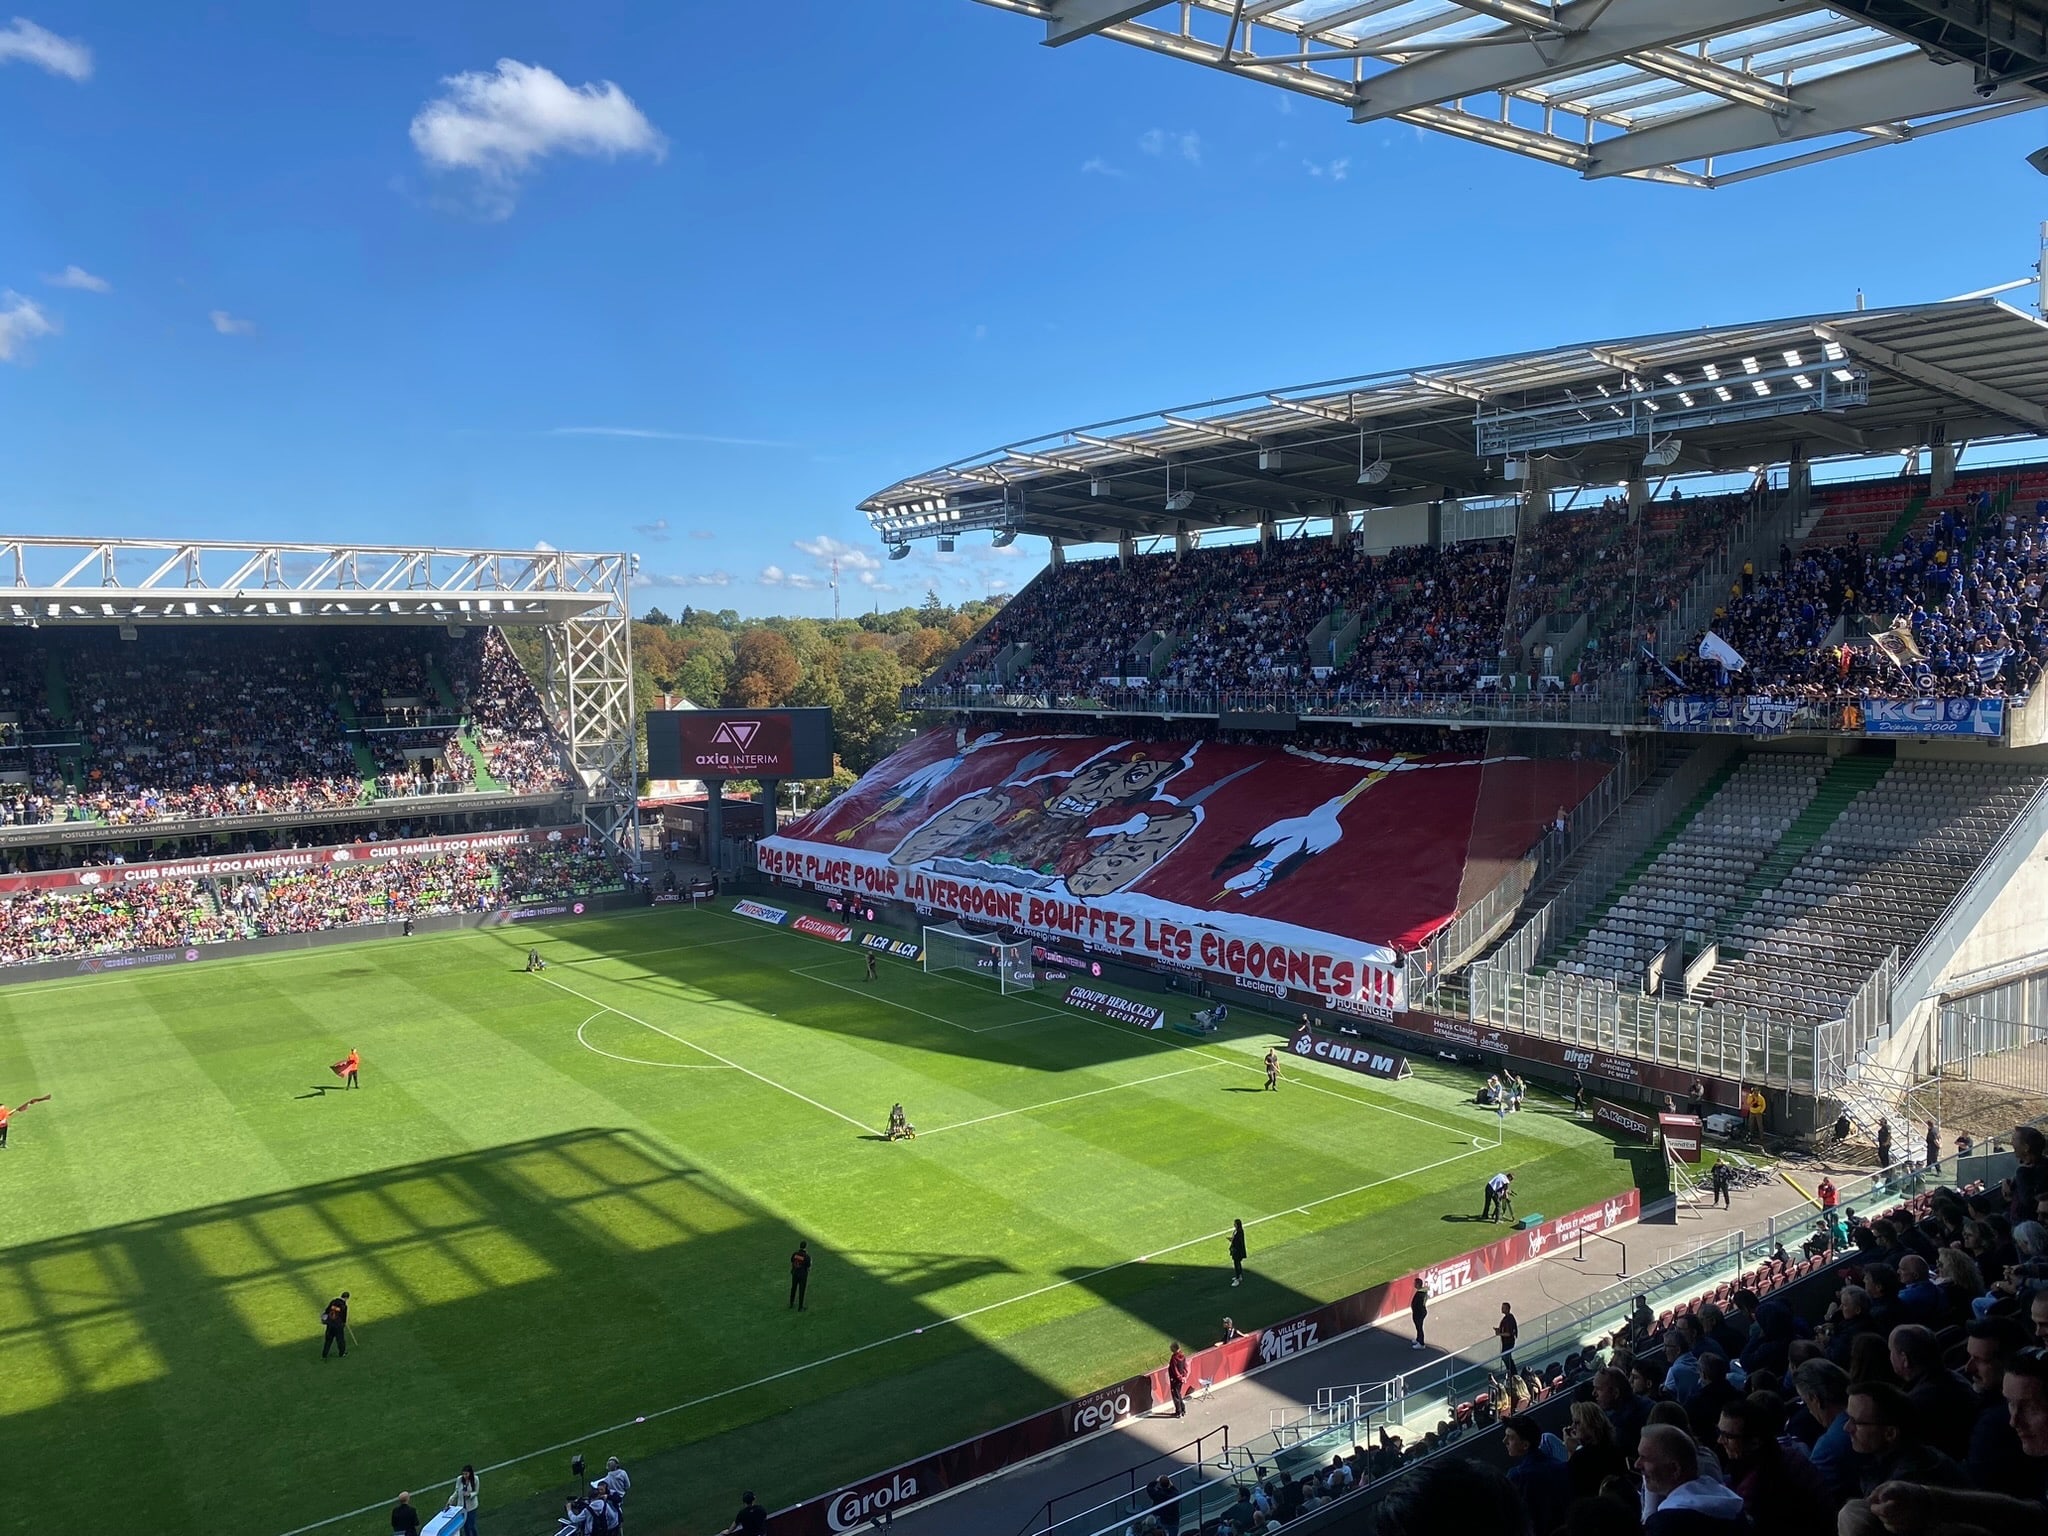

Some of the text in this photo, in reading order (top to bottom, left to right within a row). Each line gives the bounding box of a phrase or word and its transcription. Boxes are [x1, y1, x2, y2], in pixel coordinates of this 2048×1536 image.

[1923, 723, 1957, 731] 2000
[695, 752, 778, 765] axia INTERIM
[273, 814, 302, 822] POSTULEZ
[61, 831, 95, 839] POSTULEZ
[96, 829, 109, 837] SUR
[370, 834, 530, 858] CLUB FAMILLE ZOO AMNÉVILLE
[124, 853, 313, 881] CLUB FAMILLE ZOO AMNÉVILLE
[741, 903, 784, 921] INTERSPORT
[759, 845, 783, 873] PAS
[786, 852, 803, 877] DE
[806, 855, 851, 886] PLACE
[854, 865, 899, 896] POUR
[904, 872, 924, 901] LA
[1028, 897, 1135, 948] BOUFFEZ
[1144, 918, 1193, 960] LES
[1201, 932, 1355, 996] CIGOGNES
[1362, 963, 1394, 1009] !!!
[802, 918, 840, 937] COSTANTINI
[869, 934, 890, 949] LCR
[896, 942, 918, 957] LCR
[1014, 971, 1035, 980] Carola
[1045, 971, 1066, 980] Carola
[1236, 976, 1275, 994] E.Leclerc
[1070, 986, 1158, 1019] GROUPE HERACLES
[1064, 997, 1097, 1012] SURETE
[1106, 1009, 1150, 1028] SECURITE
[1433, 1020, 1478, 1036] Heiss Claude
[1480, 1035, 1509, 1049] demeco
[1314, 1041, 1394, 1072] CMPM
[1613, 1059, 1631, 1068] RADIO
[1600, 1062, 1629, 1074] OFFICIELLE
[1615, 1071, 1631, 1080] METZ
[1609, 1111, 1647, 1134] Kappa
[1428, 1263, 1472, 1298] METZ
[1278, 1319, 1307, 1336] VILLE DE
[1262, 1322, 1319, 1363] METZ
[1077, 1398, 1093, 1408] SOIF
[1106, 1385, 1125, 1397] VIVRE
[1074, 1393, 1131, 1433] rega
[827, 1474, 917, 1532] Carola
